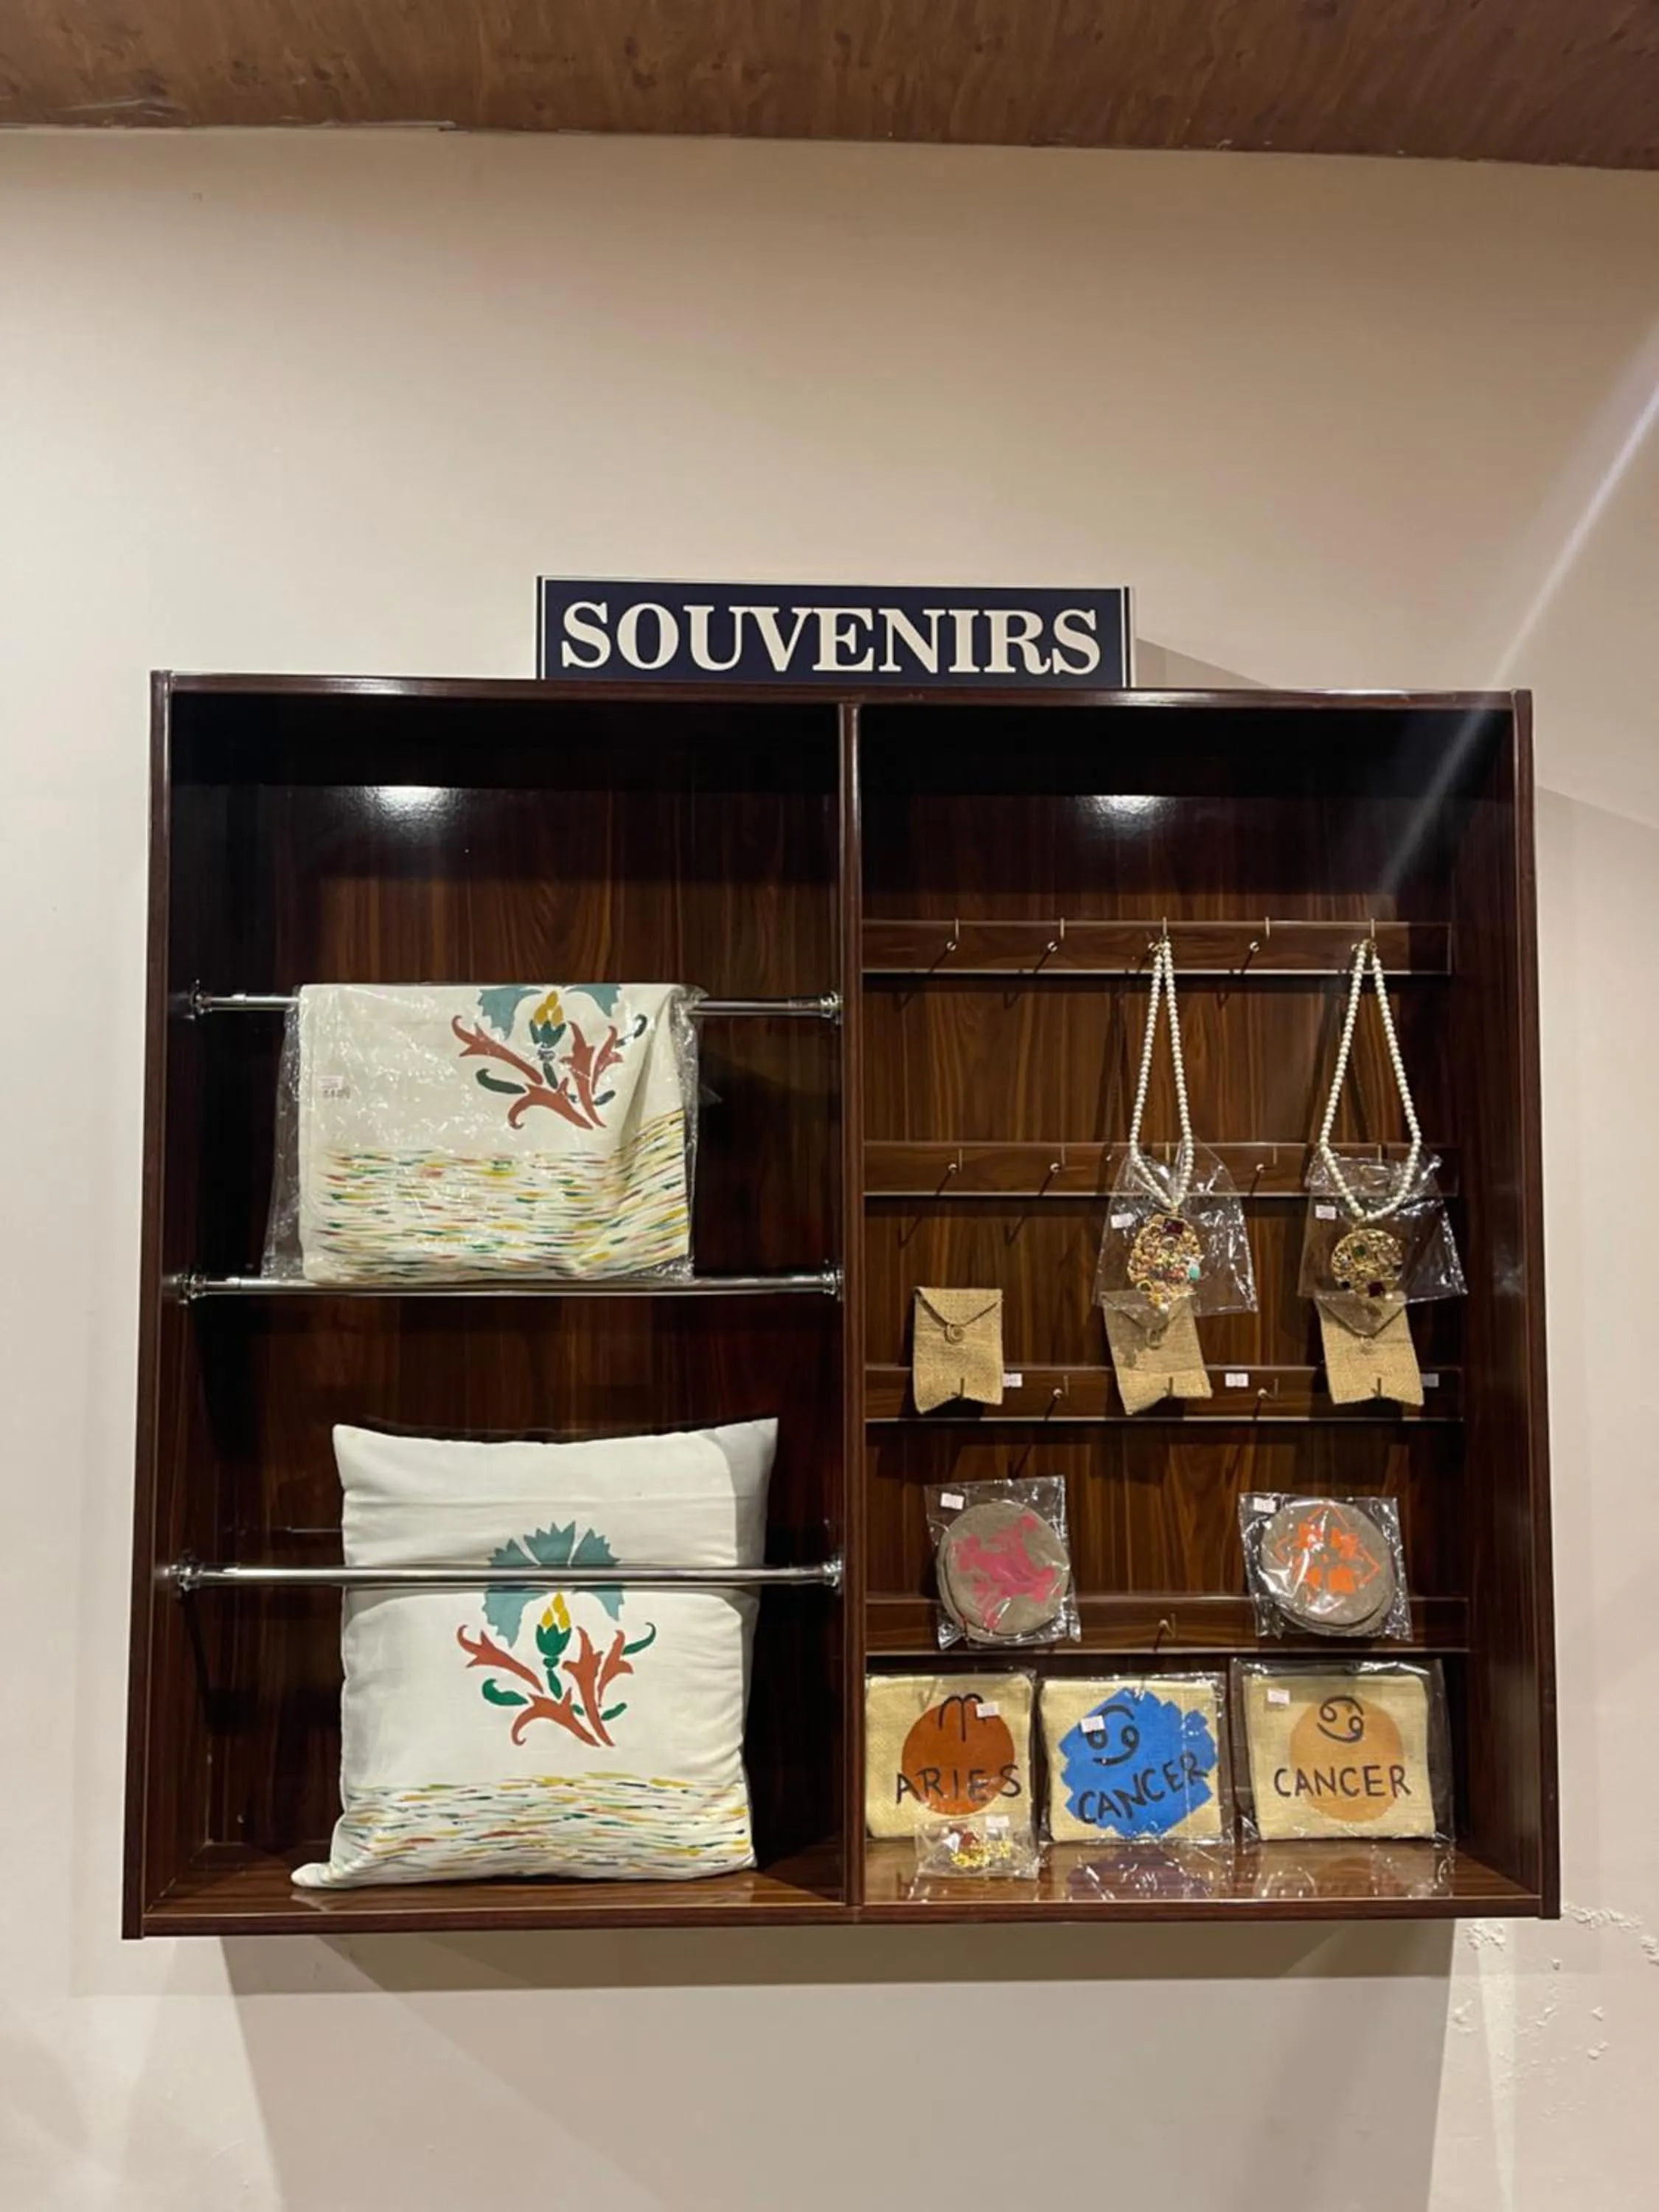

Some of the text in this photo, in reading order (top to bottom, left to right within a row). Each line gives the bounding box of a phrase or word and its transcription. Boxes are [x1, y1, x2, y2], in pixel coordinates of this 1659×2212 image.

[562, 602, 1100, 675] SOUVENIRS
[897, 1764, 1022, 1804] ARIES
[1077, 1751, 1208, 1824] CANCER
[1273, 1764, 1413, 1798] CANCER
